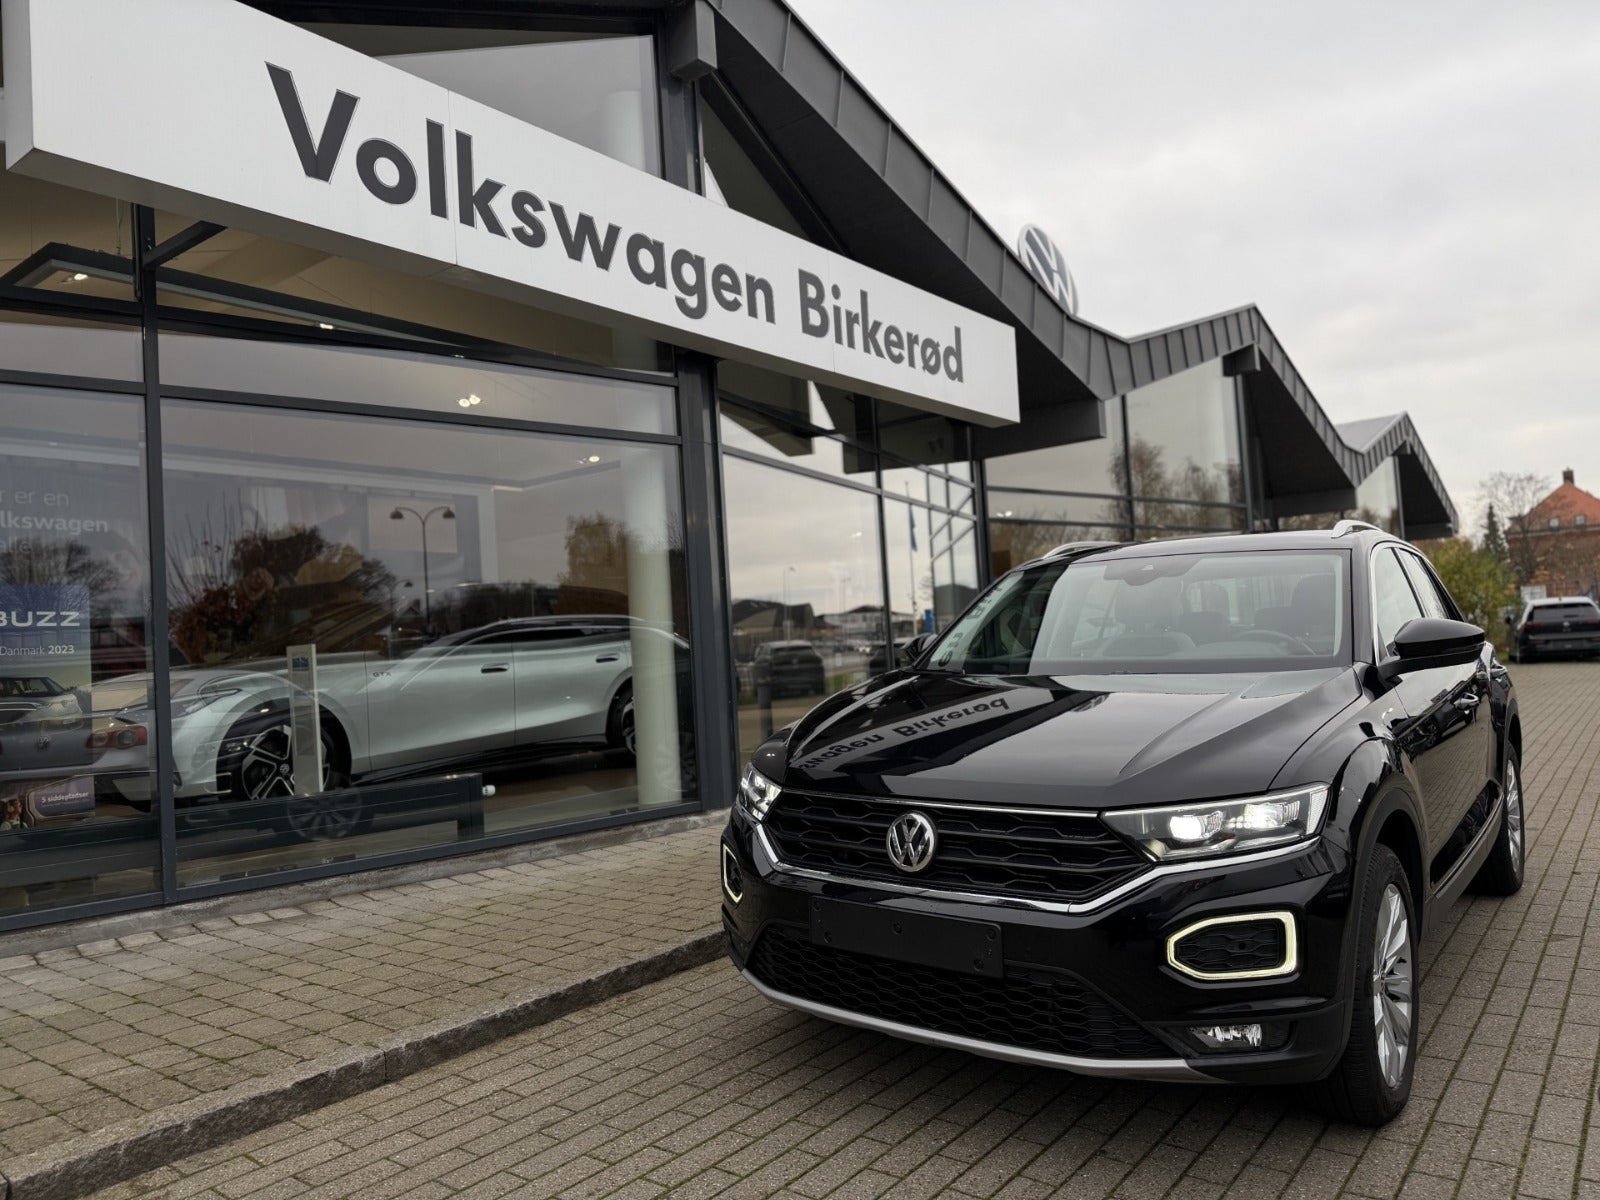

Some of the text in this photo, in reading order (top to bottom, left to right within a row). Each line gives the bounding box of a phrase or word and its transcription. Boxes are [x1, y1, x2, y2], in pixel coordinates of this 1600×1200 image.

[265, 61, 964, 384] Volkswagen Birkerød
[43, 492, 70, 507] en
[47, 644, 75, 655] 2023
